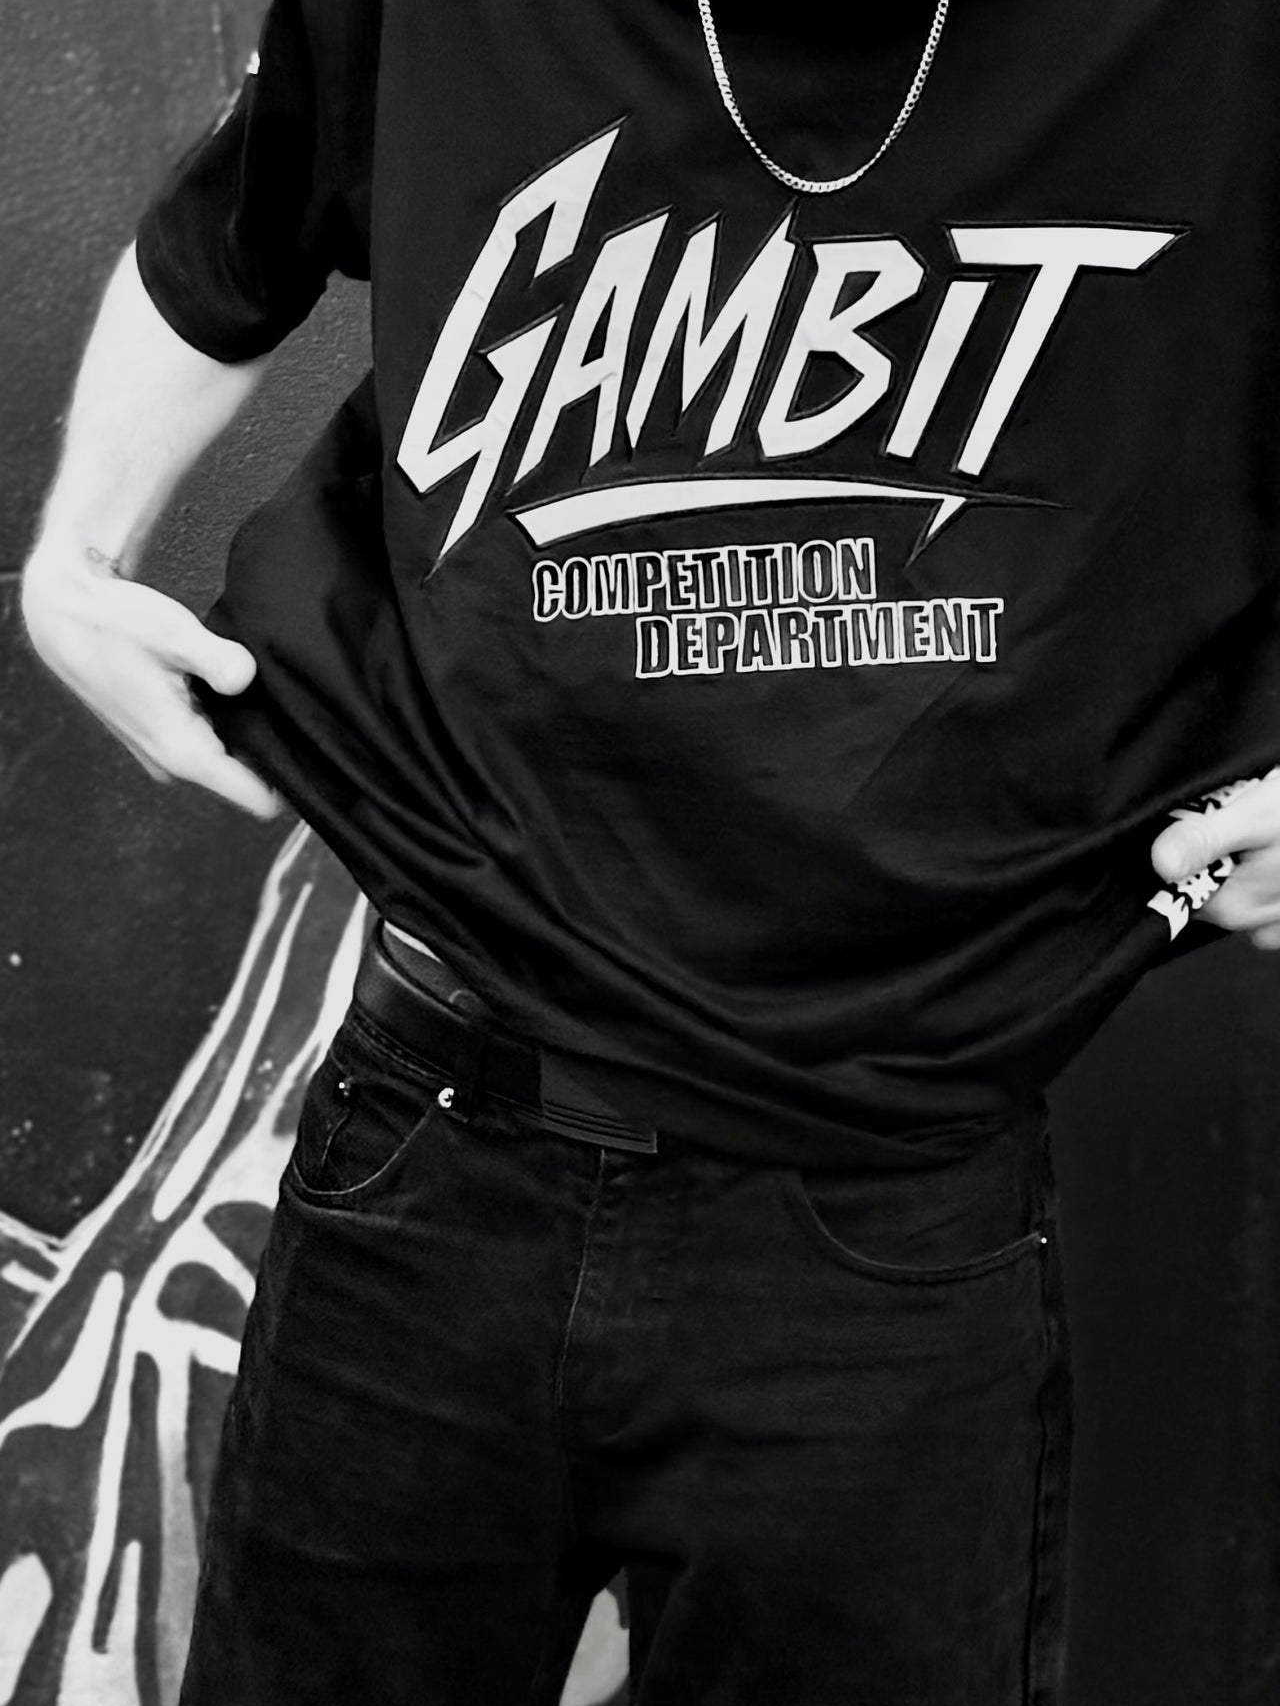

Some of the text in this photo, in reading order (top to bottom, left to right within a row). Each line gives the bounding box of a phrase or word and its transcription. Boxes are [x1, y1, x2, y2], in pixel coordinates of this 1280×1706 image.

[395, 123, 1182, 563] GAMBIT
[531, 536, 878, 624] COMPETITION
[634, 596, 1006, 680] DEPARTMENT
